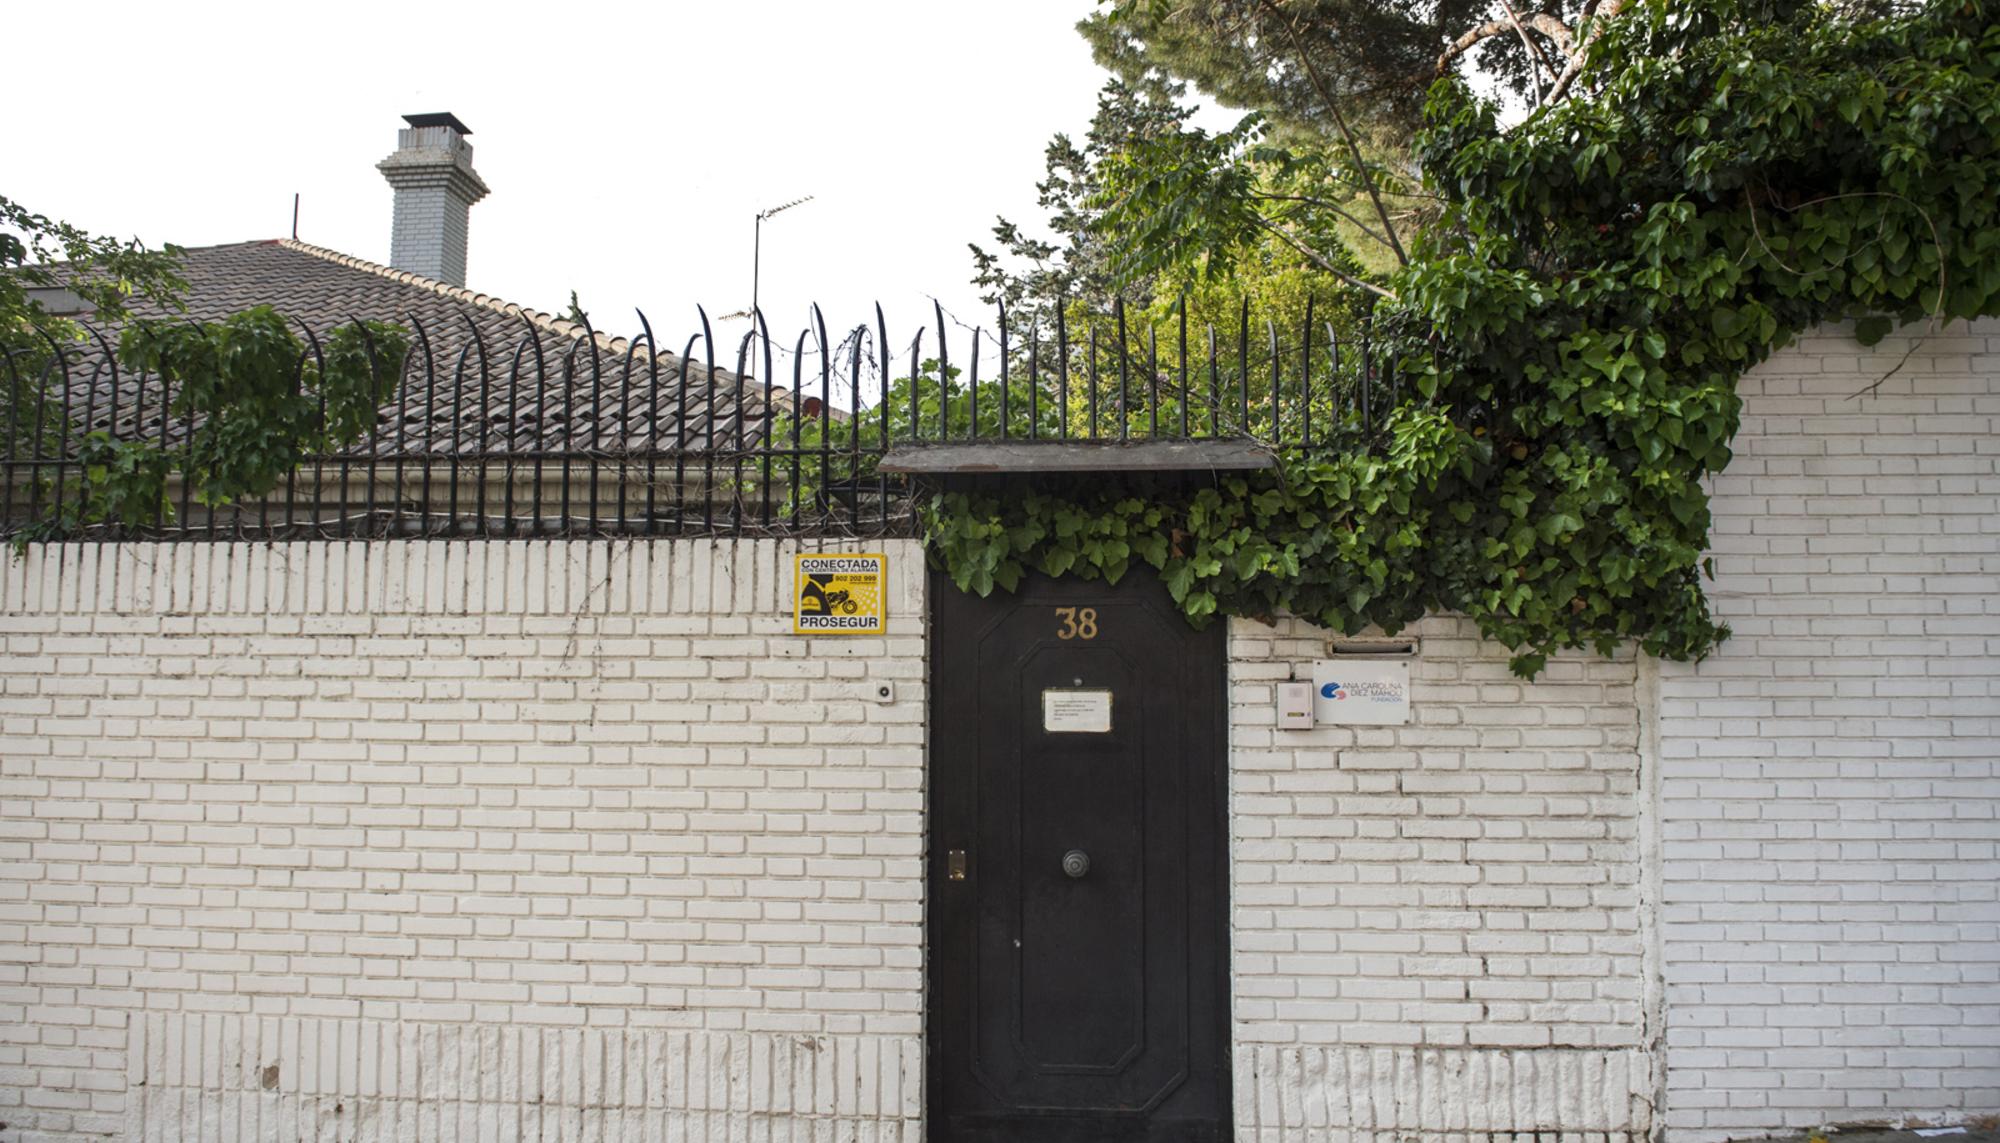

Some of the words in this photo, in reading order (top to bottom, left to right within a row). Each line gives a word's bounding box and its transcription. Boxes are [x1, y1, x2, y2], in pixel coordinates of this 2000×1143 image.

[801, 560, 878, 568] CONECTADA
[800, 617, 878, 627] PROSEGUR
[1056, 606, 1098, 640] 38
